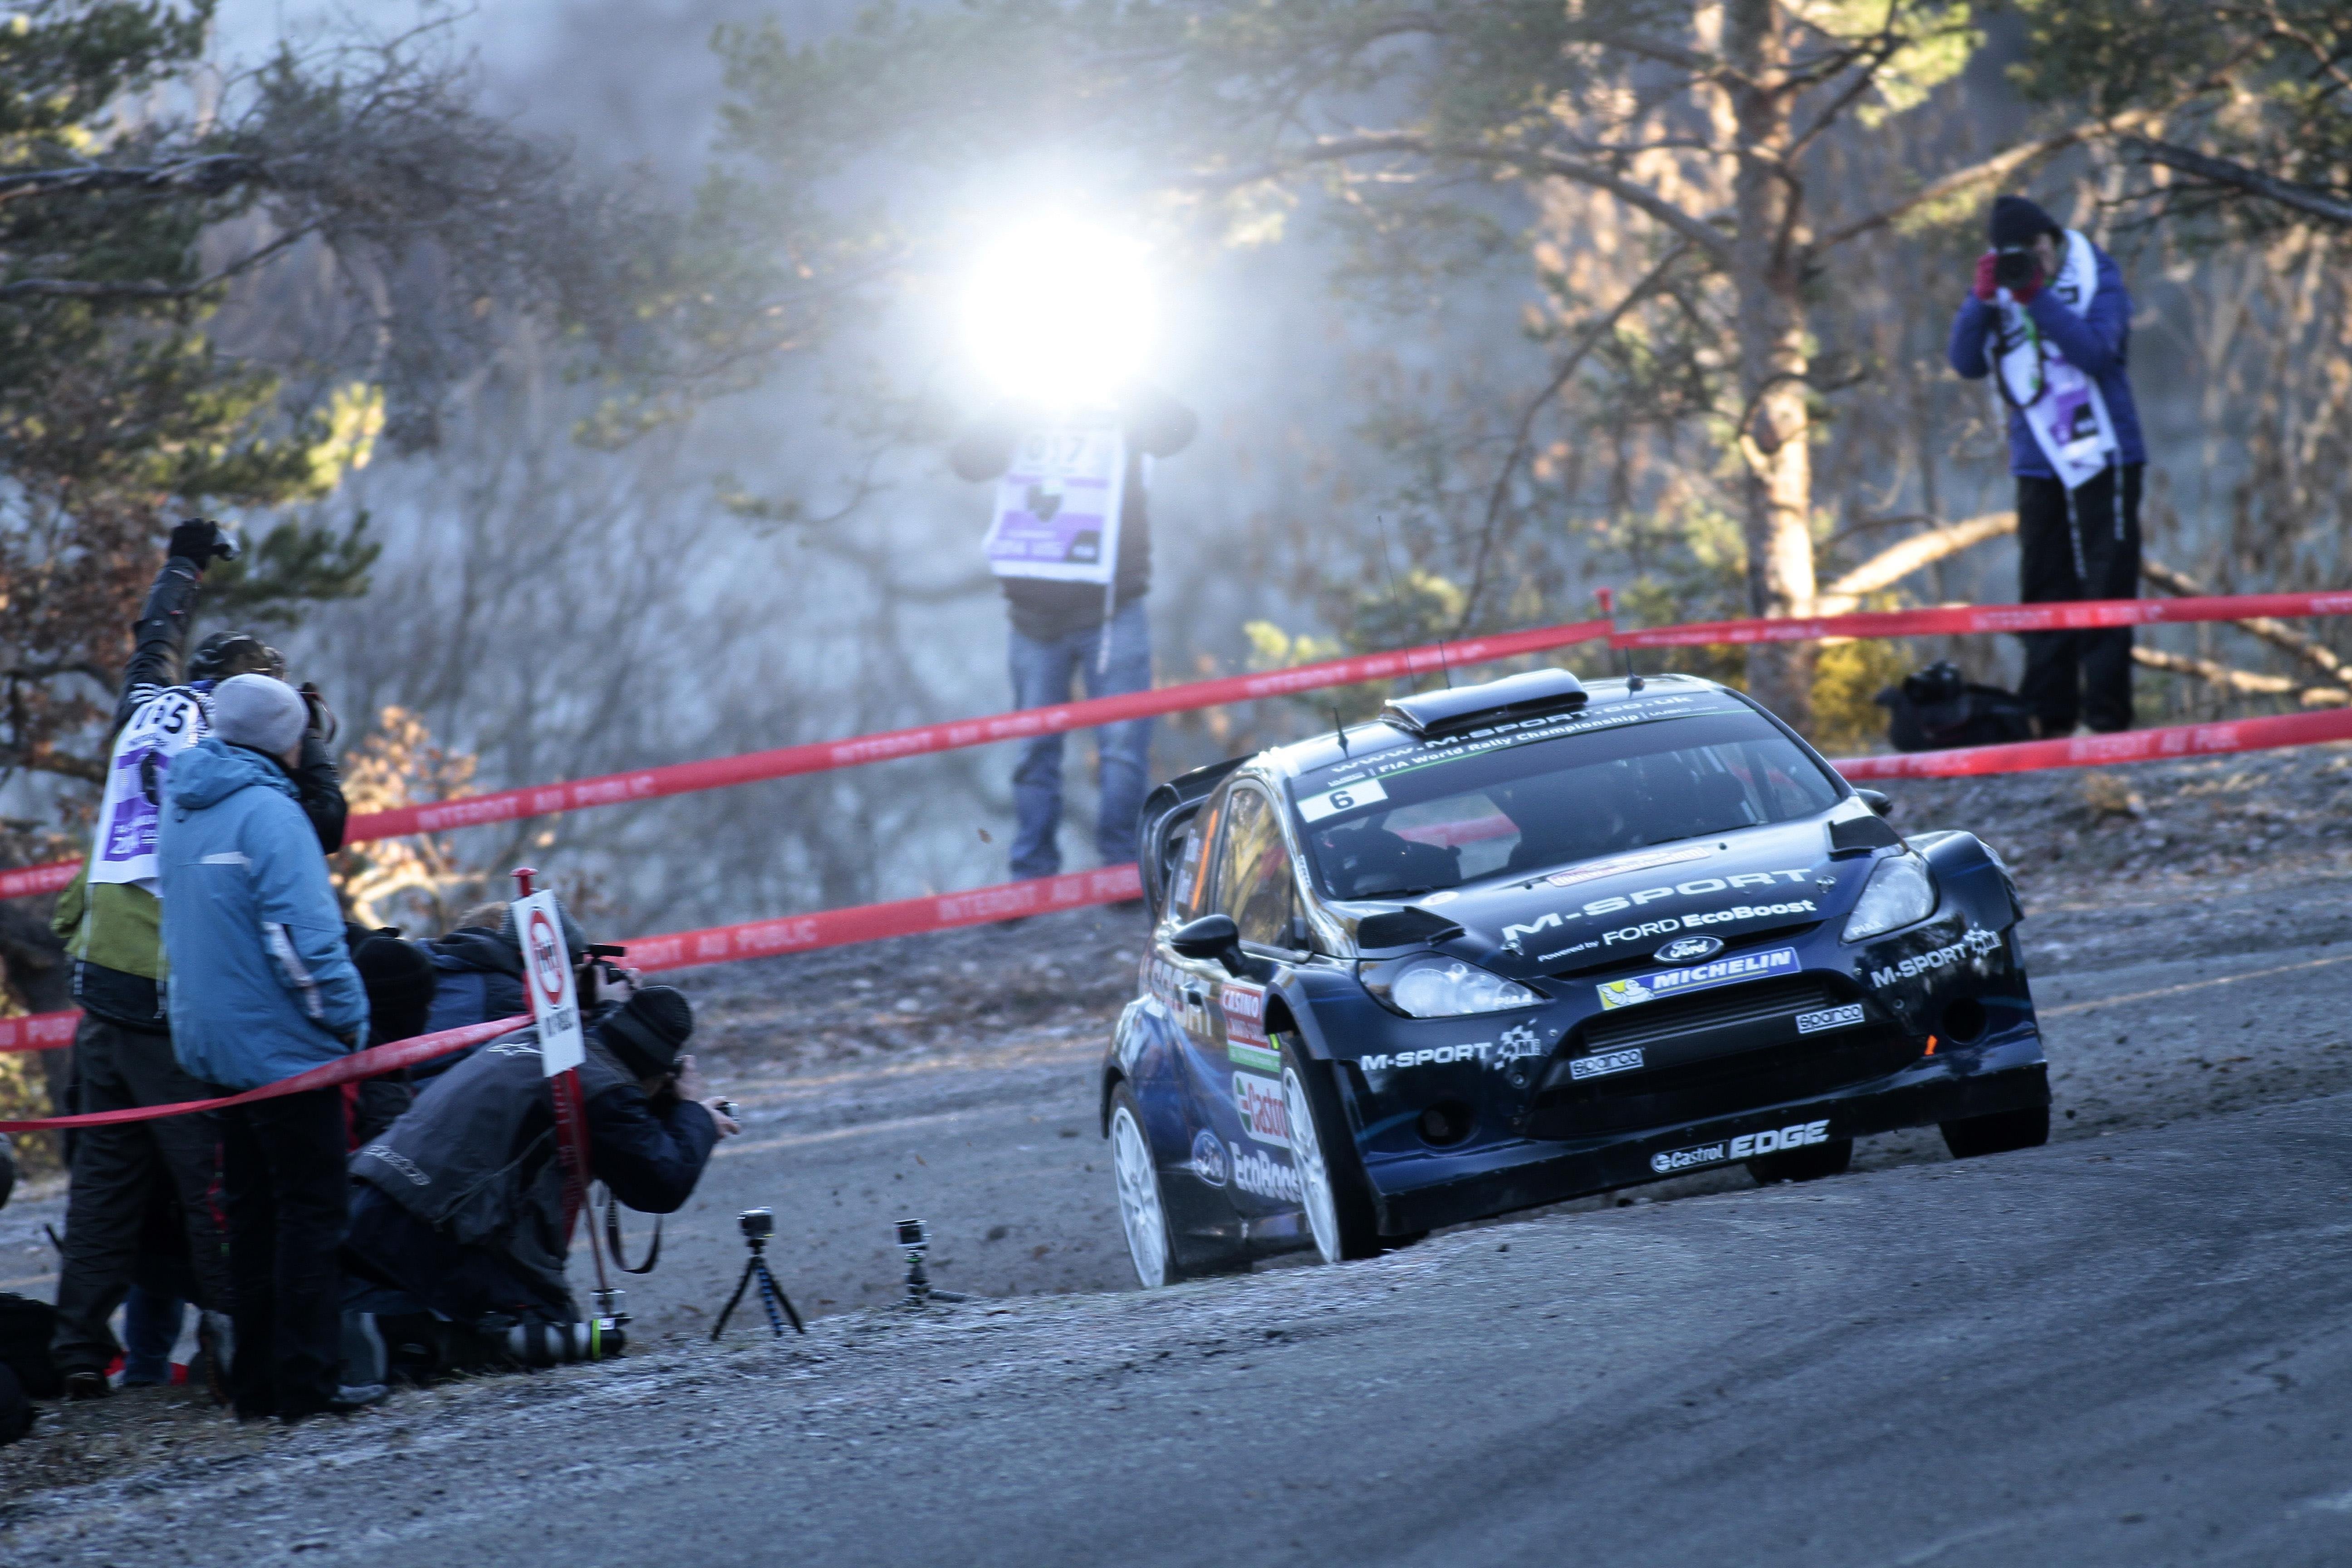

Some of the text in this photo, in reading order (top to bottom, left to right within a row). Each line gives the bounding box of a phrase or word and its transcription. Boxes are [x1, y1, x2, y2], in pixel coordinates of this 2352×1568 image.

[1379, 760, 1409, 773] FIA
[1411, 747, 1464, 764] World
[1468, 736, 1512, 751] Rally
[1516, 714, 1640, 740] Championship
[1329, 790, 1354, 810] 6
[1502, 868, 1812, 941] M-SPORT
[1538, 899, 1817, 962] Powered by FORD EcoBoost
[1670, 939, 1710, 958] Ford
[1652, 951, 1791, 989] MICHELIN
[1870, 943, 1967, 988] M-SPORT
[1800, 1006, 1859, 1028] sparco
[1361, 1042, 1493, 1071] M-SPORT
[1574, 1050, 1639, 1074] sparco
[1671, 1143, 1725, 1168] Castrol
[1729, 1119, 1830, 1160] EDGE
[1229, 1141, 1303, 1203] EcoBoos
